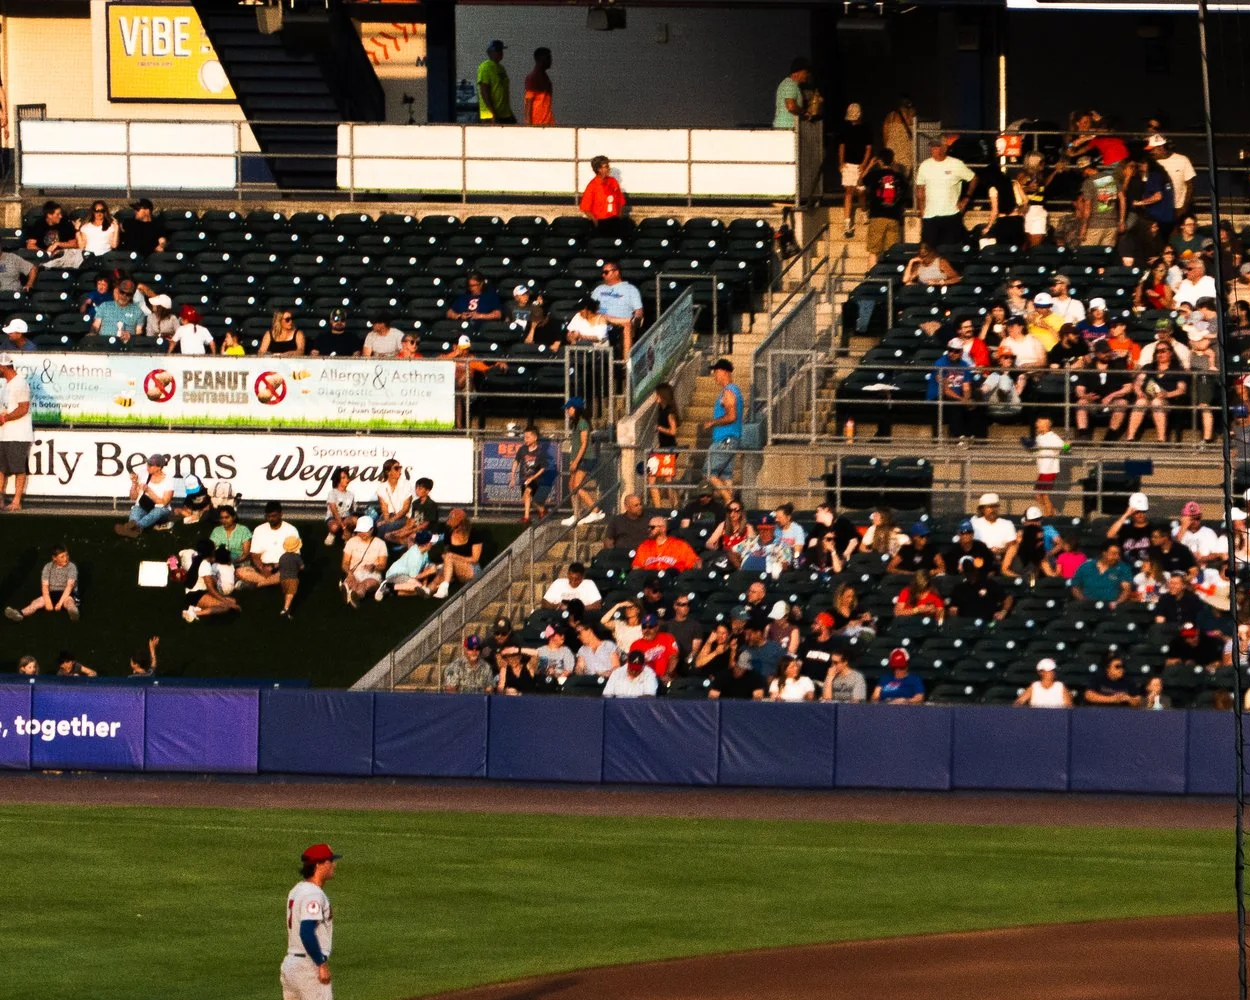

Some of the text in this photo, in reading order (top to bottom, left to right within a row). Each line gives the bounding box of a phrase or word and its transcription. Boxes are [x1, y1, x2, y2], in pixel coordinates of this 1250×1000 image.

[60, 364, 112, 377] Asthma
[320, 364, 445, 390] Allergy & Asthma
[68, 382, 100, 391] Office
[182, 370, 249, 391] PEANUT
[182, 391, 249, 405] CONTROLLED
[317, 387, 433, 398] Diagnostic Office
[312, 446, 398, 459] Sponsored by
[27, 438, 238, 485] ily Bems
[261, 446, 414, 497] Wegas
[14, 713, 121, 741] together
